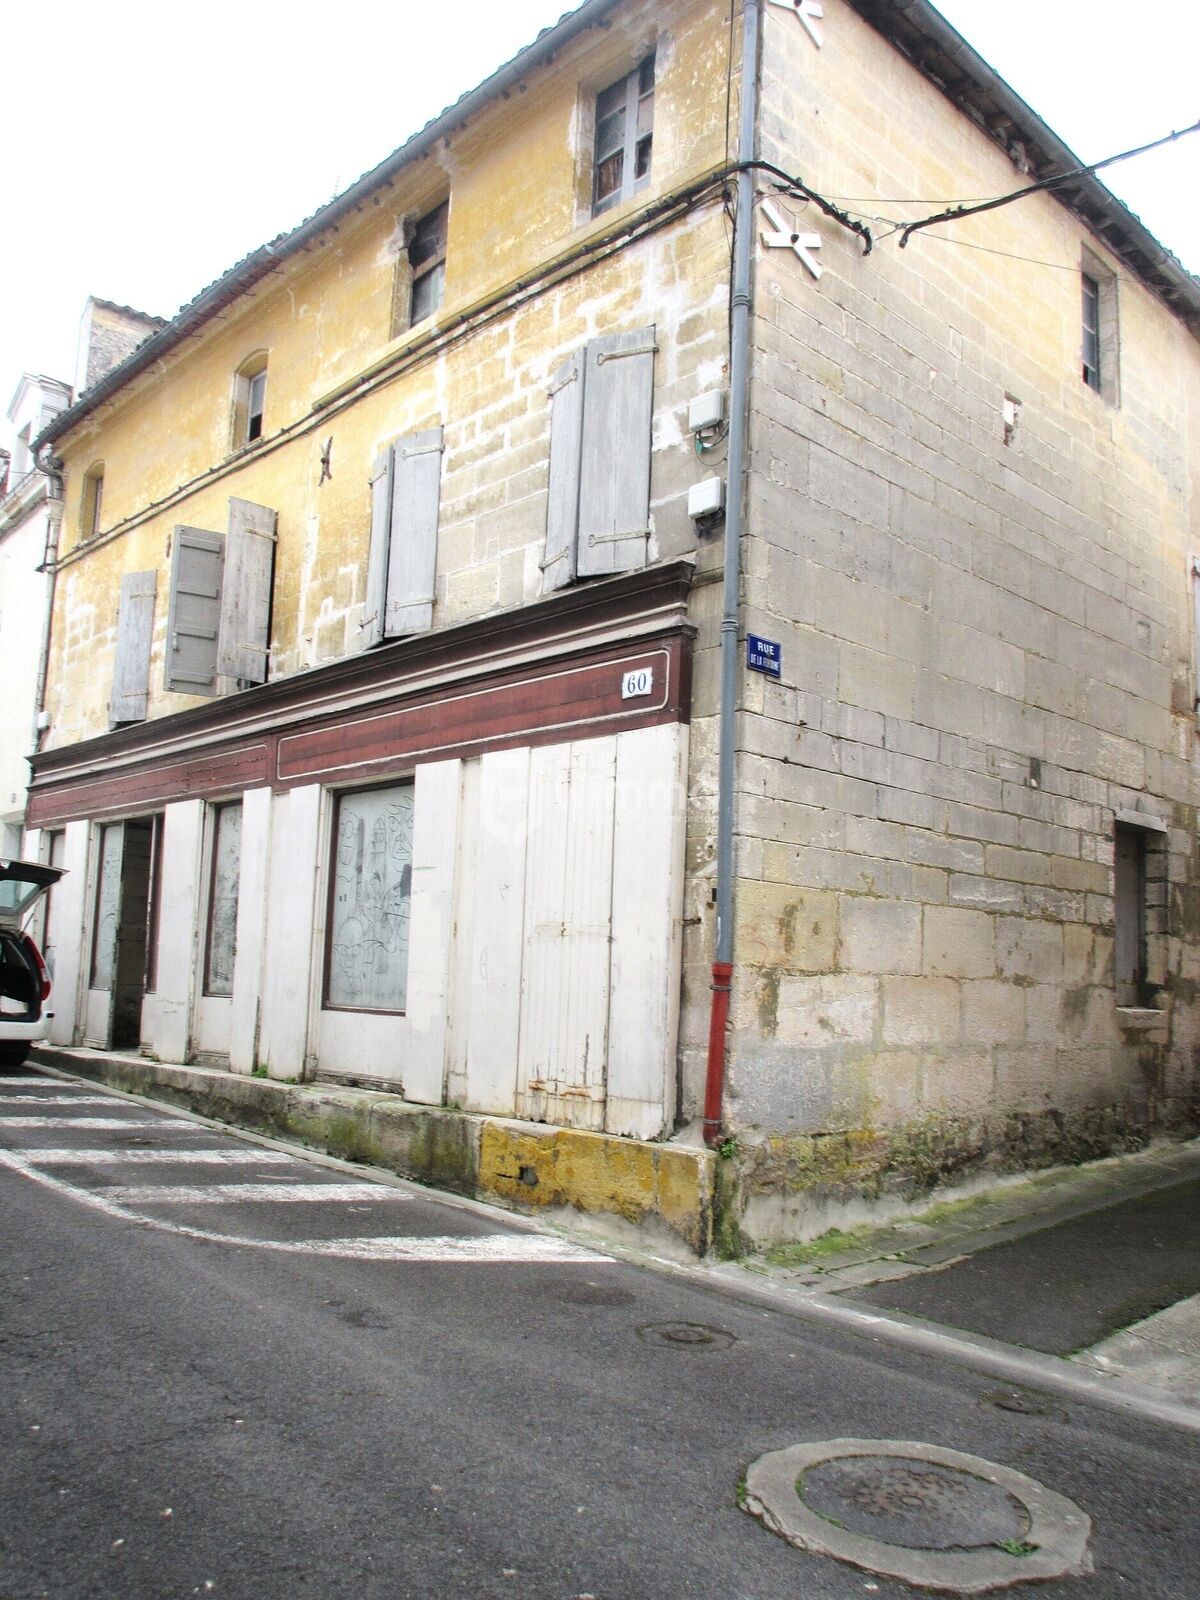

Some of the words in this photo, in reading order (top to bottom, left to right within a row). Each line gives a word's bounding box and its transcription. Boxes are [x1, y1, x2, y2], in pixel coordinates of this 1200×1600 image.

[757, 641, 774, 655] RUE
[750, 653, 756, 664] DE
[627, 672, 647, 693] 60
